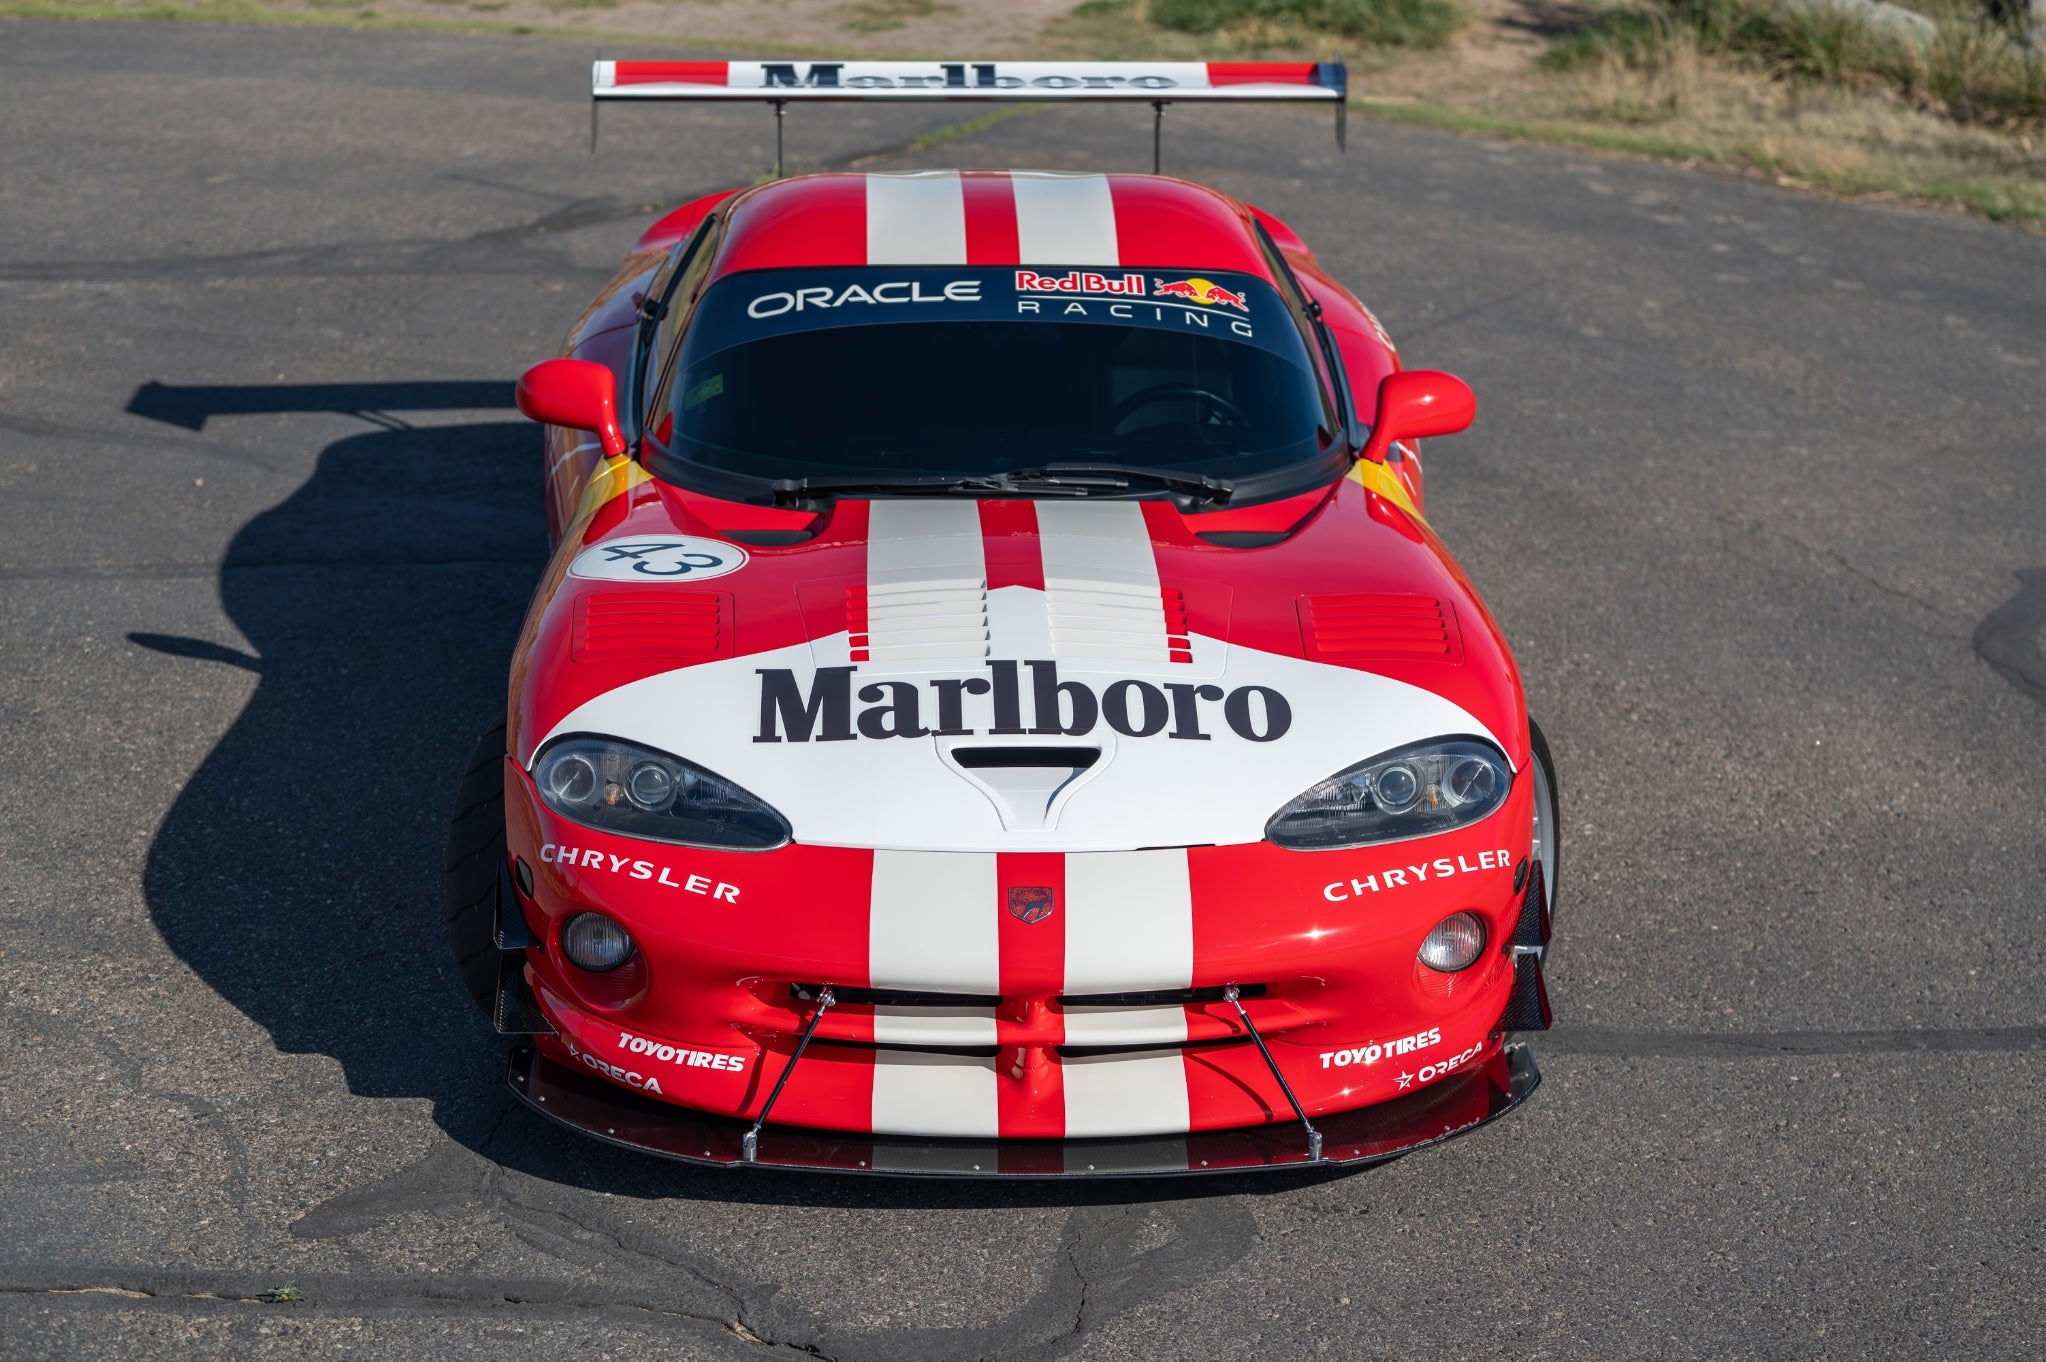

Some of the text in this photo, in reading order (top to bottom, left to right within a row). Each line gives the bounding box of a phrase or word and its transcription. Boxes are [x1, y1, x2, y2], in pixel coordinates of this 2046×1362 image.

[758, 63, 1179, 89] Marlboro
[747, 280, 983, 319] ORACLE
[1015, 271, 1147, 296] Red Bull
[1017, 301, 1253, 338] RACING
[600, 543, 724, 576] 43
[751, 659, 1293, 744] Marlboro
[540, 844, 742, 905] CHRYSLER
[1323, 849, 1512, 903] CHRYSLER
[582, 1053, 663, 1095] ORECA
[1418, 1040, 1483, 1083] ORECA
